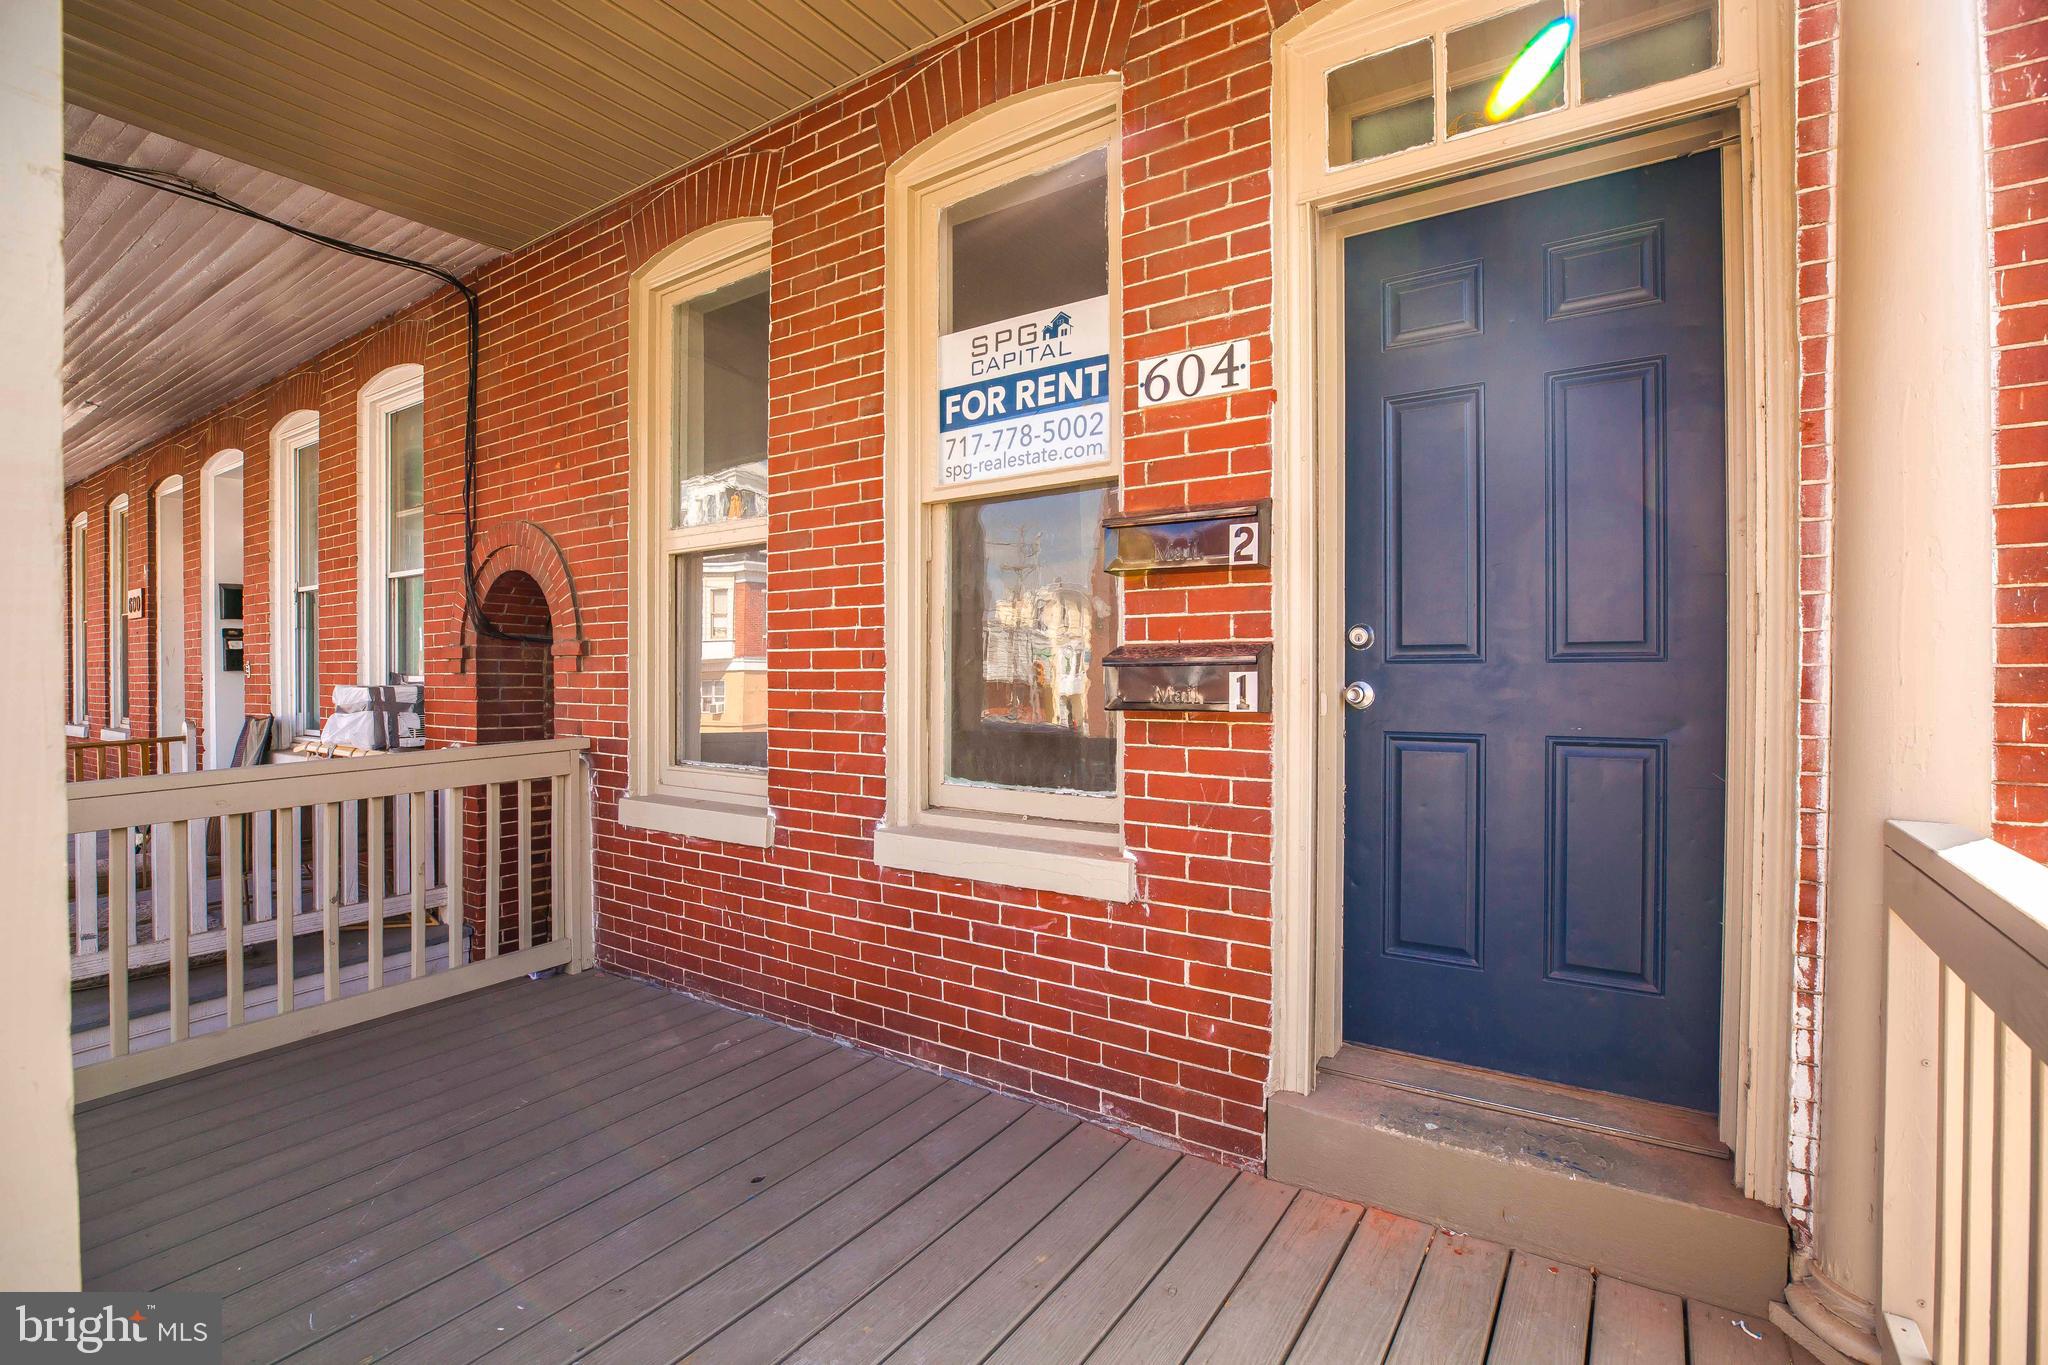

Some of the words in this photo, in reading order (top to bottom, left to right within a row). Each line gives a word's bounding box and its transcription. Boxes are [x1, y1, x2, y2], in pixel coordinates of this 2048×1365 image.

[971, 323, 1037, 358] SPG
[971, 341, 1072, 376] CAPITAL
[1144, 343, 1240, 402] 604
[945, 385, 1006, 425] FOR
[1016, 363, 1107, 411] RENT
[945, 412, 1104, 461] 717-778-5002
[945, 441, 1103, 482] spg-realestate.com
[1233, 526, 1254, 562] 2
[1236, 674, 1250, 711] 1
